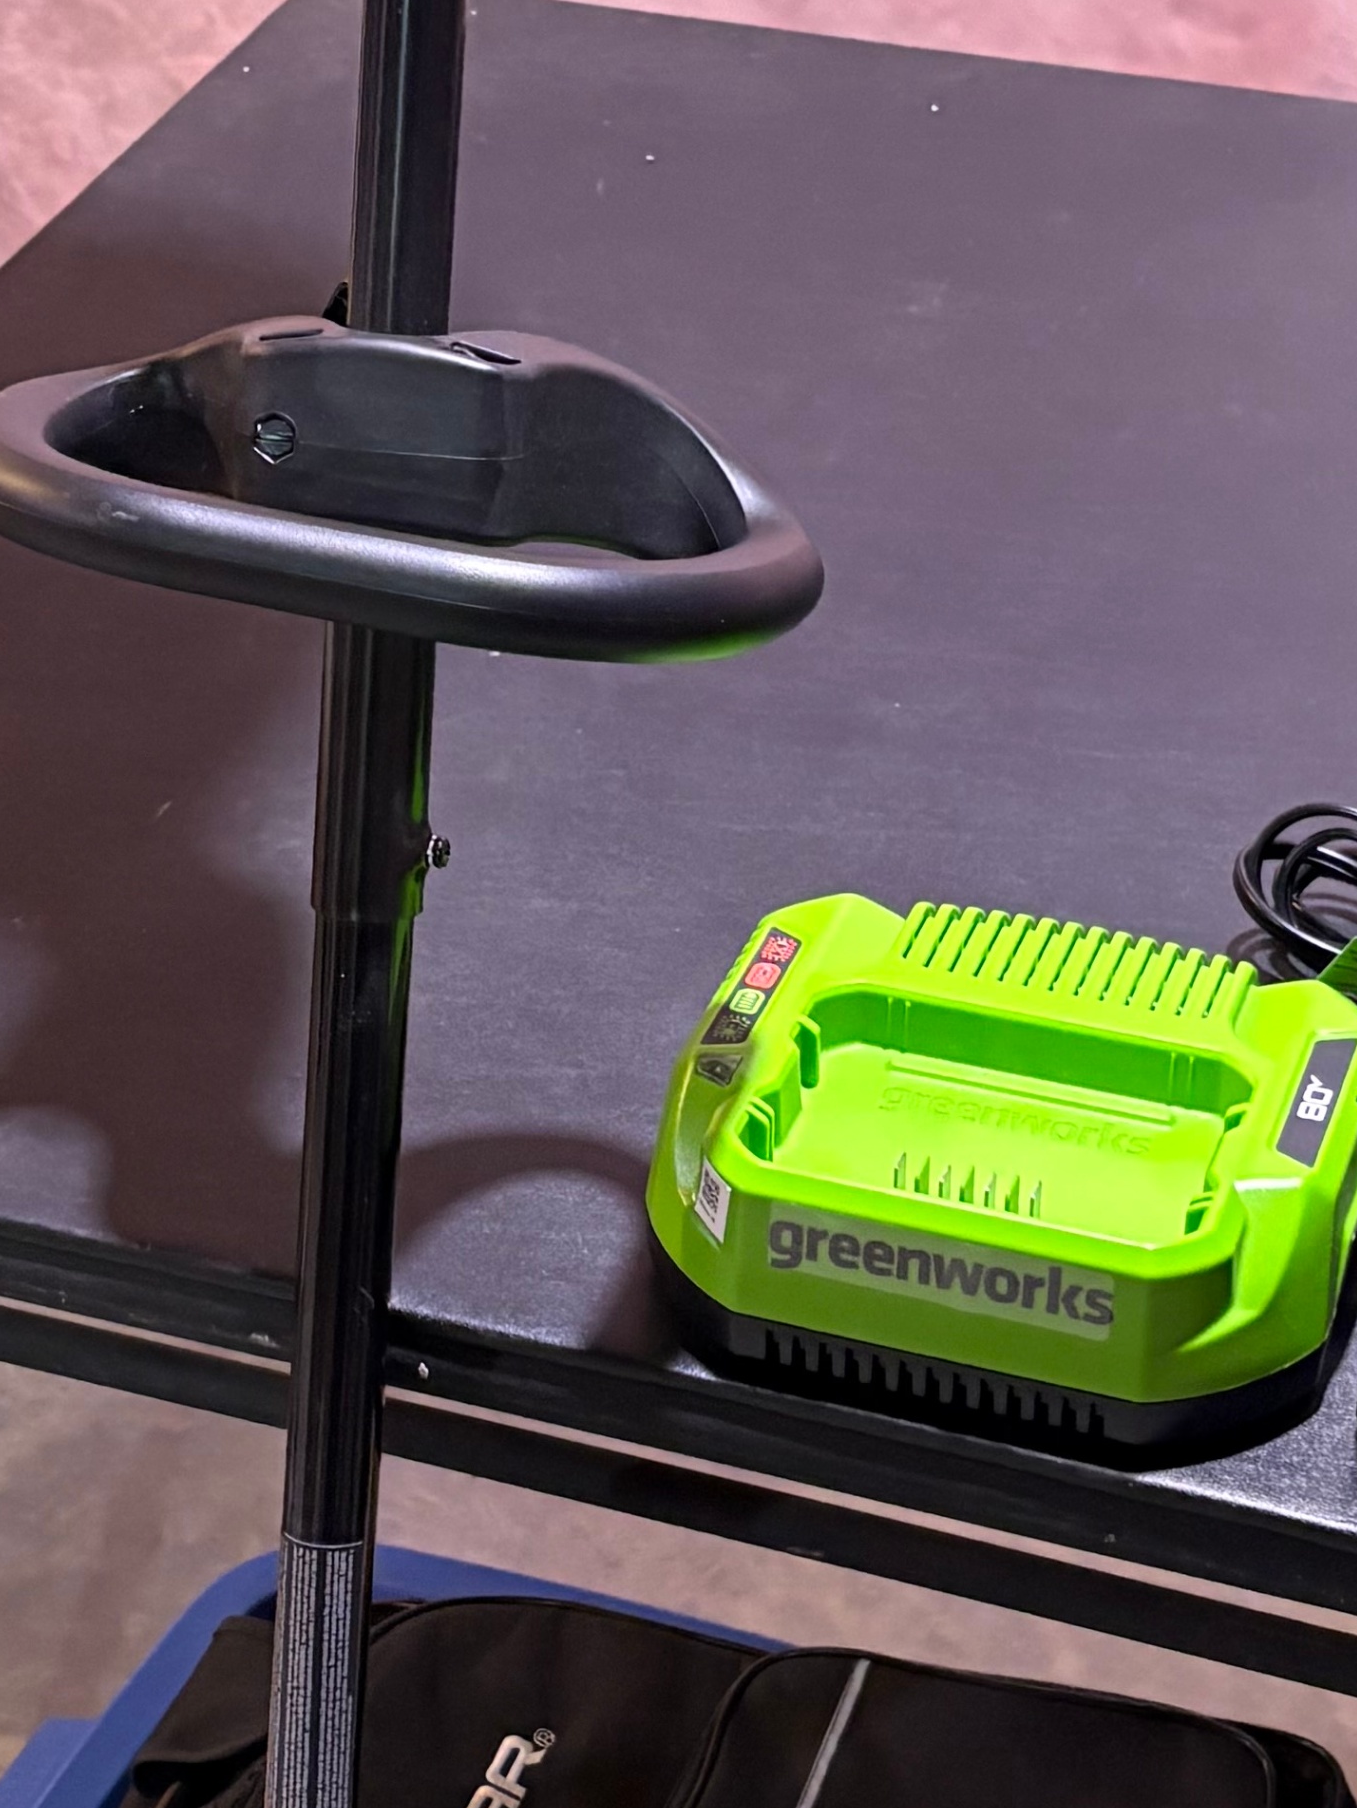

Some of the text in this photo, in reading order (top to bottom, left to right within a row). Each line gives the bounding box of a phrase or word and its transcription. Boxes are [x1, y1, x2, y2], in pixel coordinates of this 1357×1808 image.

[879, 1086, 1153, 1155] greenworks
[1296, 1074, 1334, 1122] 80V
[770, 1220, 1115, 1326] greenworks
